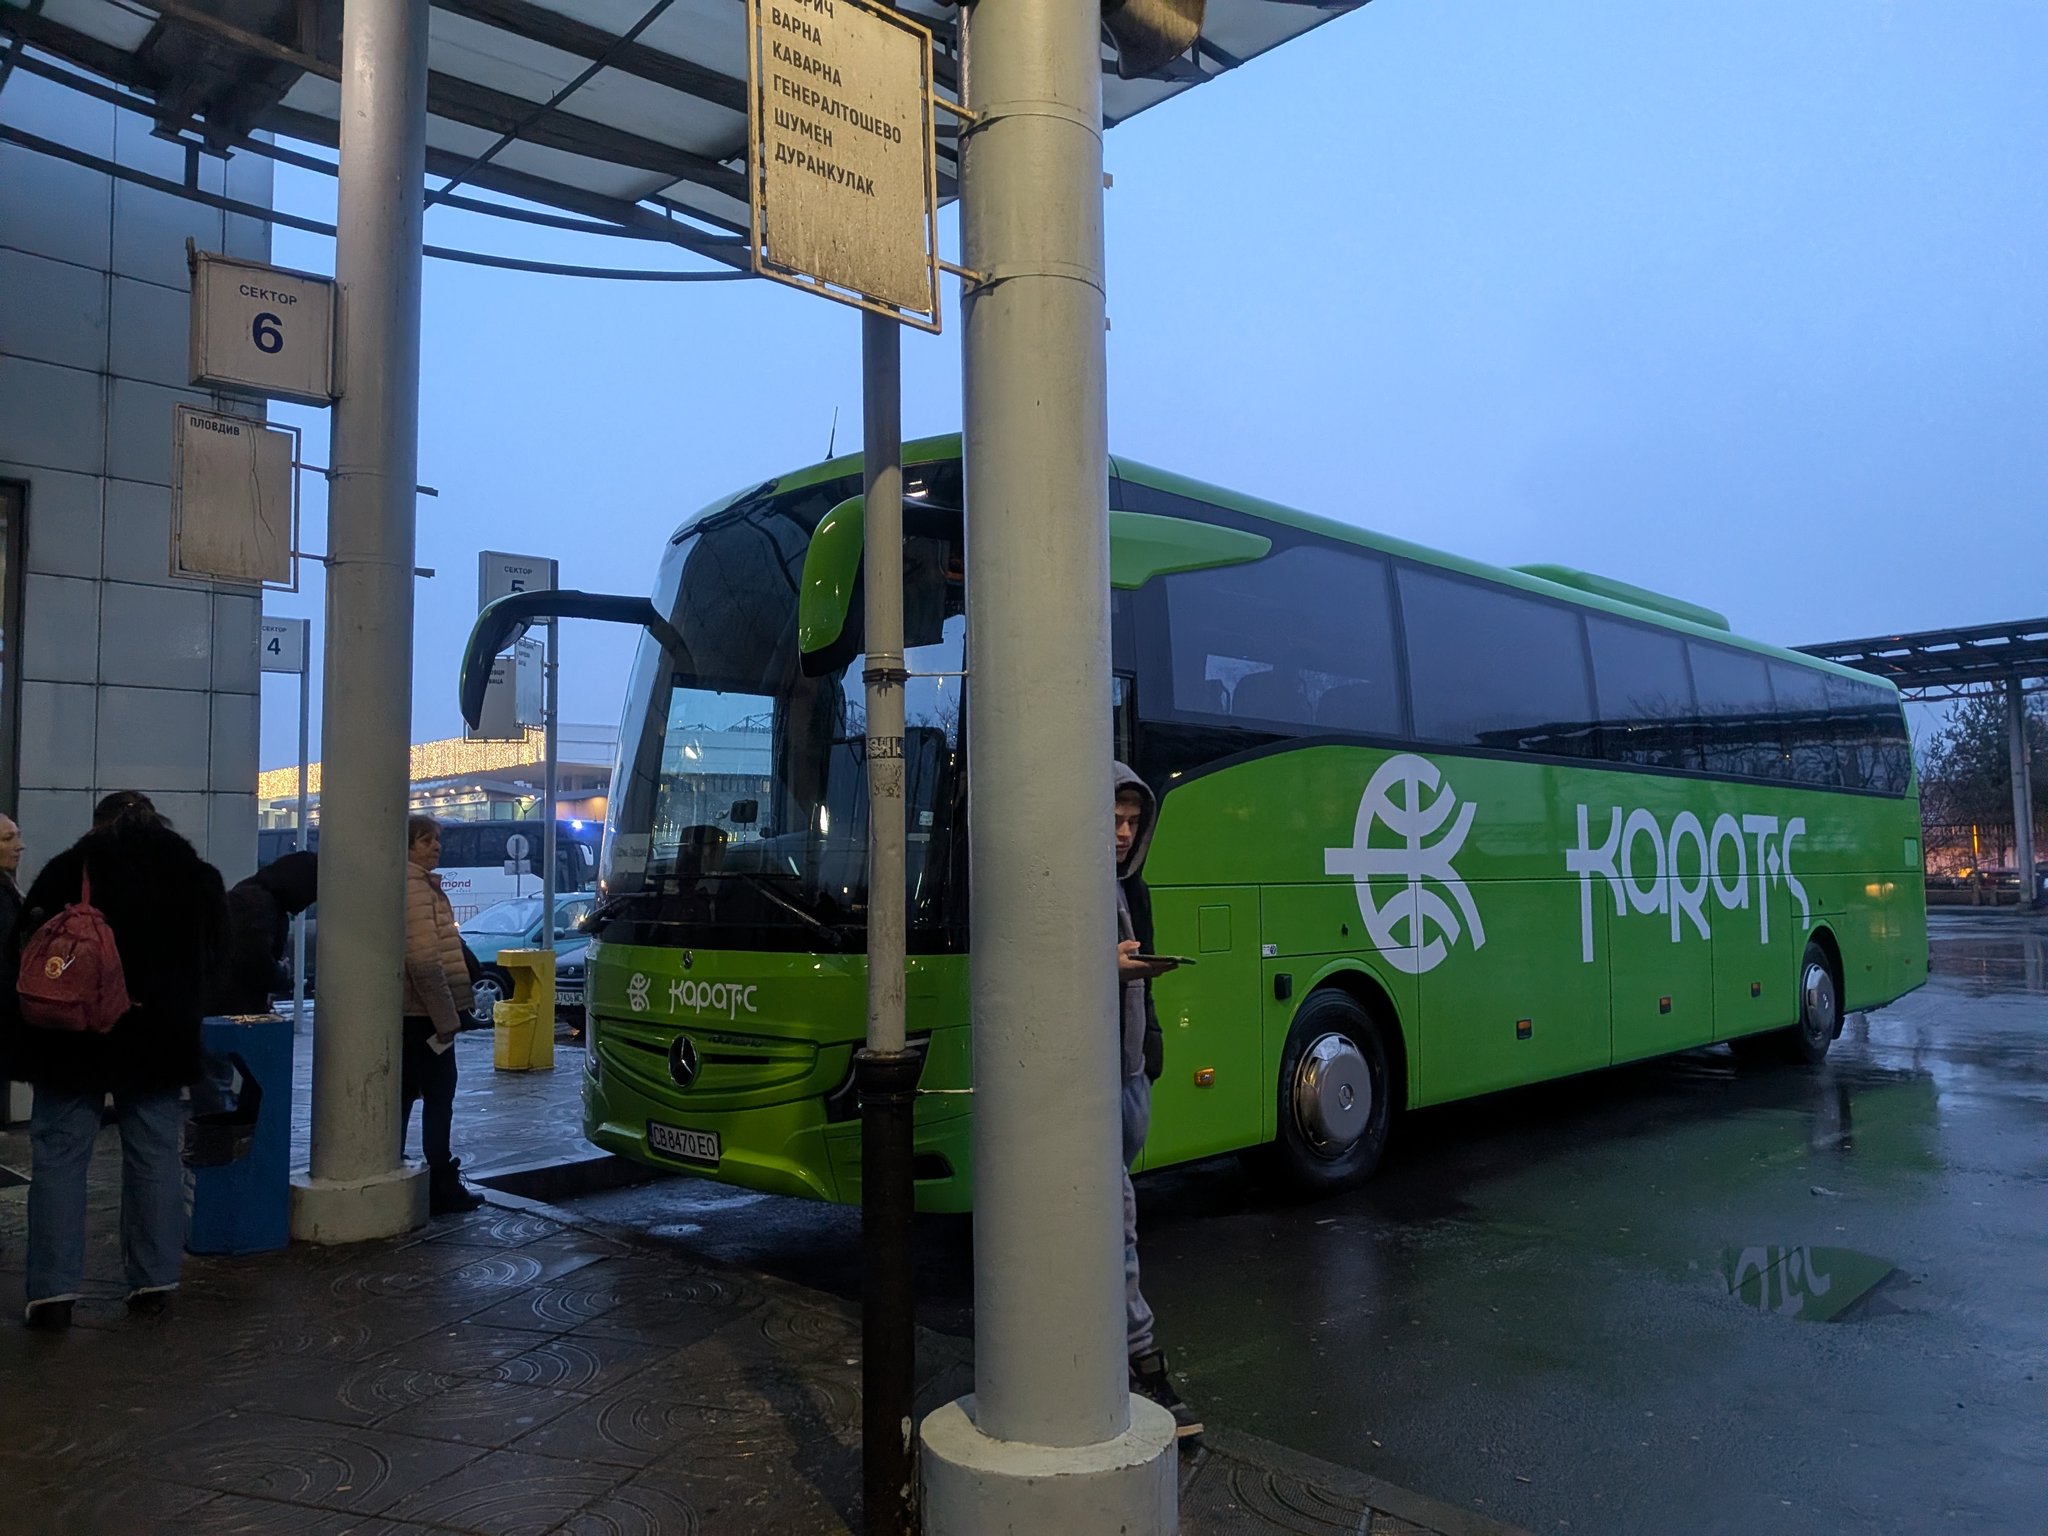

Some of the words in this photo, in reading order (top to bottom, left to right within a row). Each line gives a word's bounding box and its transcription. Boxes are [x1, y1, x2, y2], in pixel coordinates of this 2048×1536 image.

[772, 7, 822, 46] ВАРНА
[772, 40, 842, 87] КАВАРНА
[773, 74, 902, 144] ГЕНЕРАЛТОШЕВО
[775, 107, 833, 147] ШУМЕН
[775, 142, 875, 197] ДУРАНКУЛАК
[239, 284, 298, 306] СЕКТОР
[252, 312, 284, 354] 6
[190, 417, 240, 436] ПЛОВДИВ
[504, 566, 533, 575] СЕКТОР
[511, 580, 525, 592] 5
[267, 637, 281, 655] 4
[441, 879, 472, 888] mond
[668, 1130, 696, 1153] 8470
